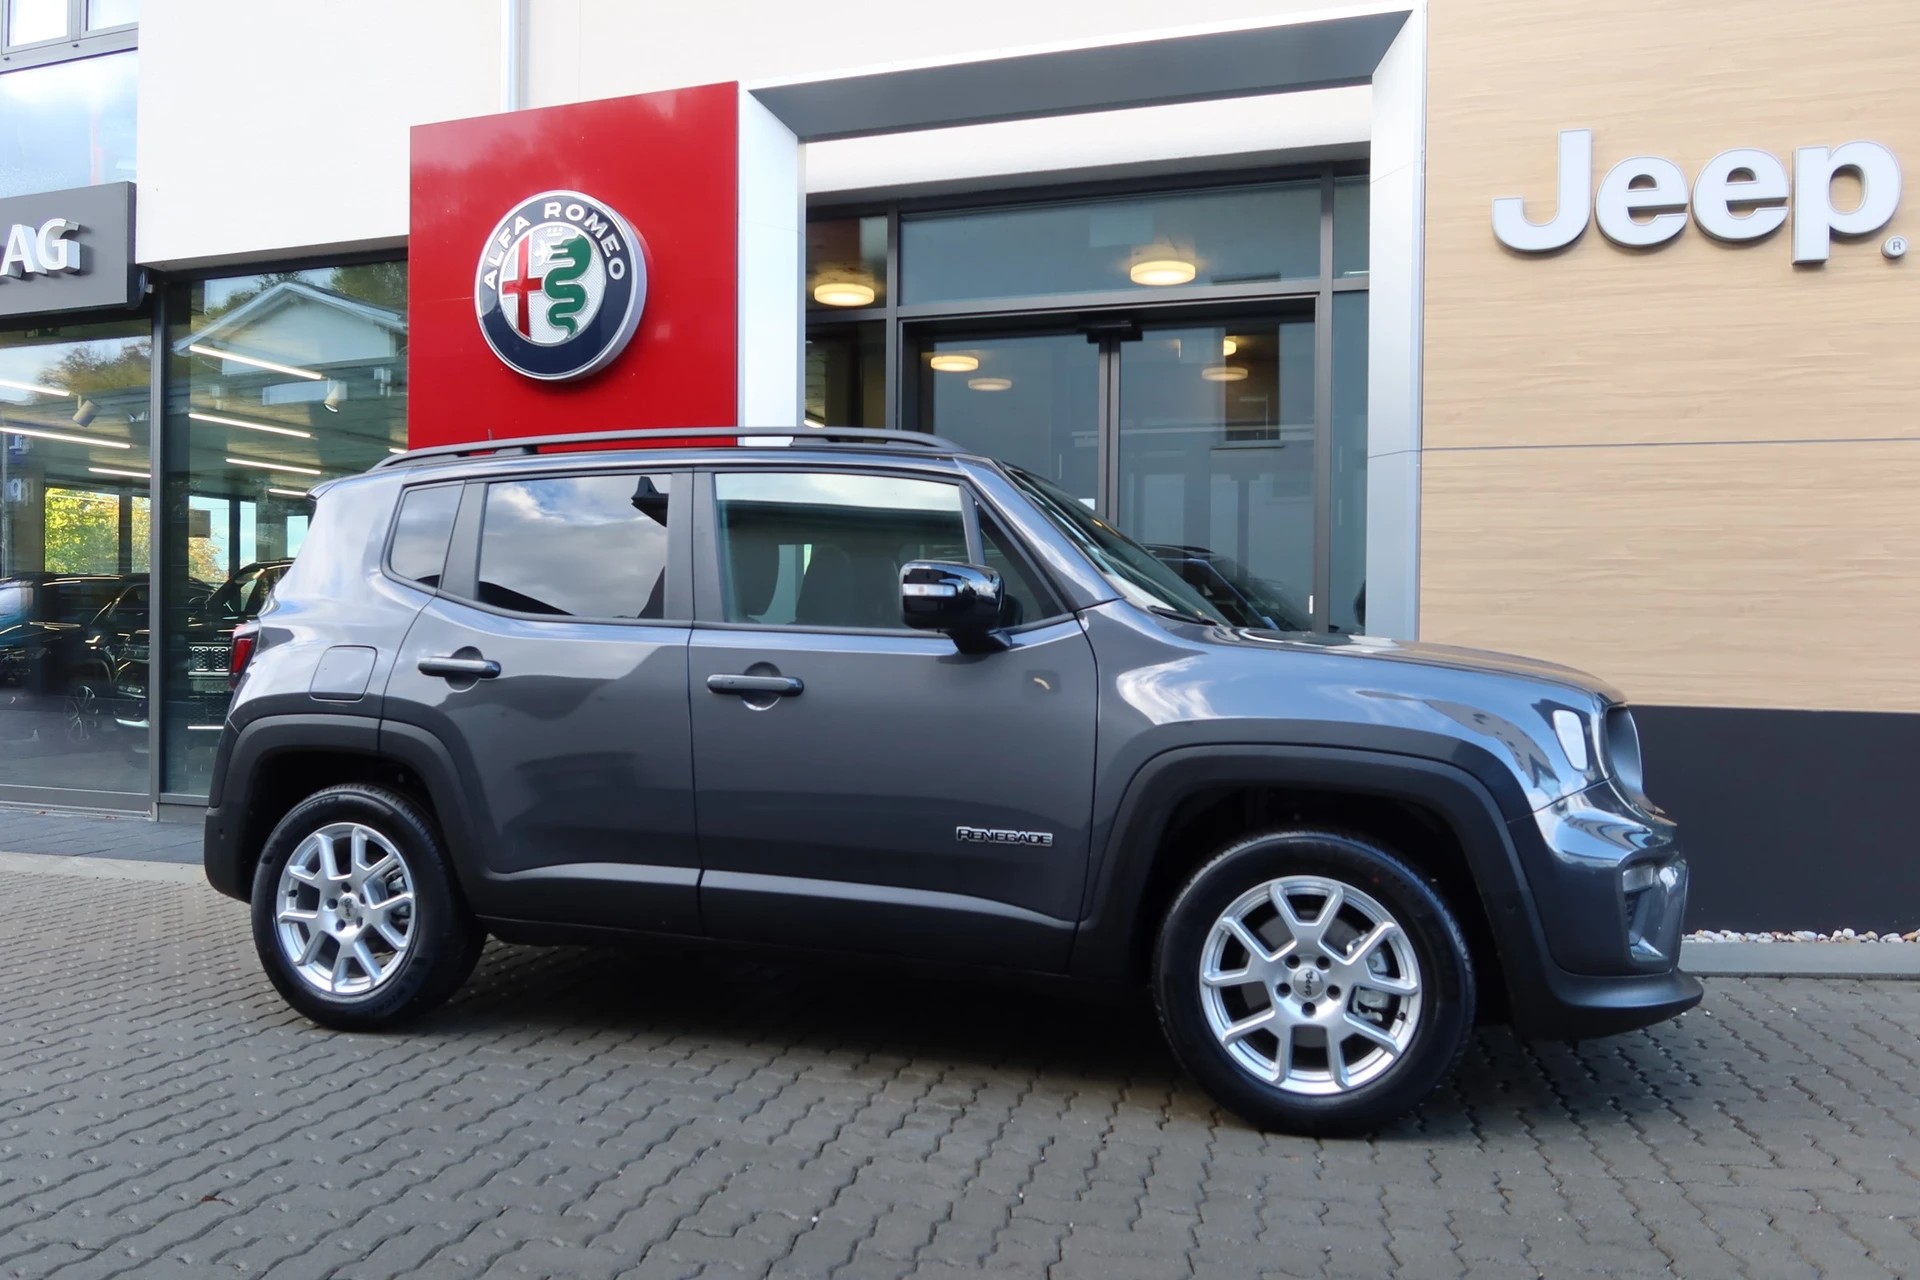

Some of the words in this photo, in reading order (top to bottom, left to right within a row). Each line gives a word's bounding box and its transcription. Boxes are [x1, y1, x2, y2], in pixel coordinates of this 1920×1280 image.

[1491, 128, 1902, 265] Jeep
[0, 217, 81, 278] AG
[484, 215, 531, 290] ALFA
[543, 201, 626, 281] ROMEO
[956, 826, 1053, 847] RENEGADE
